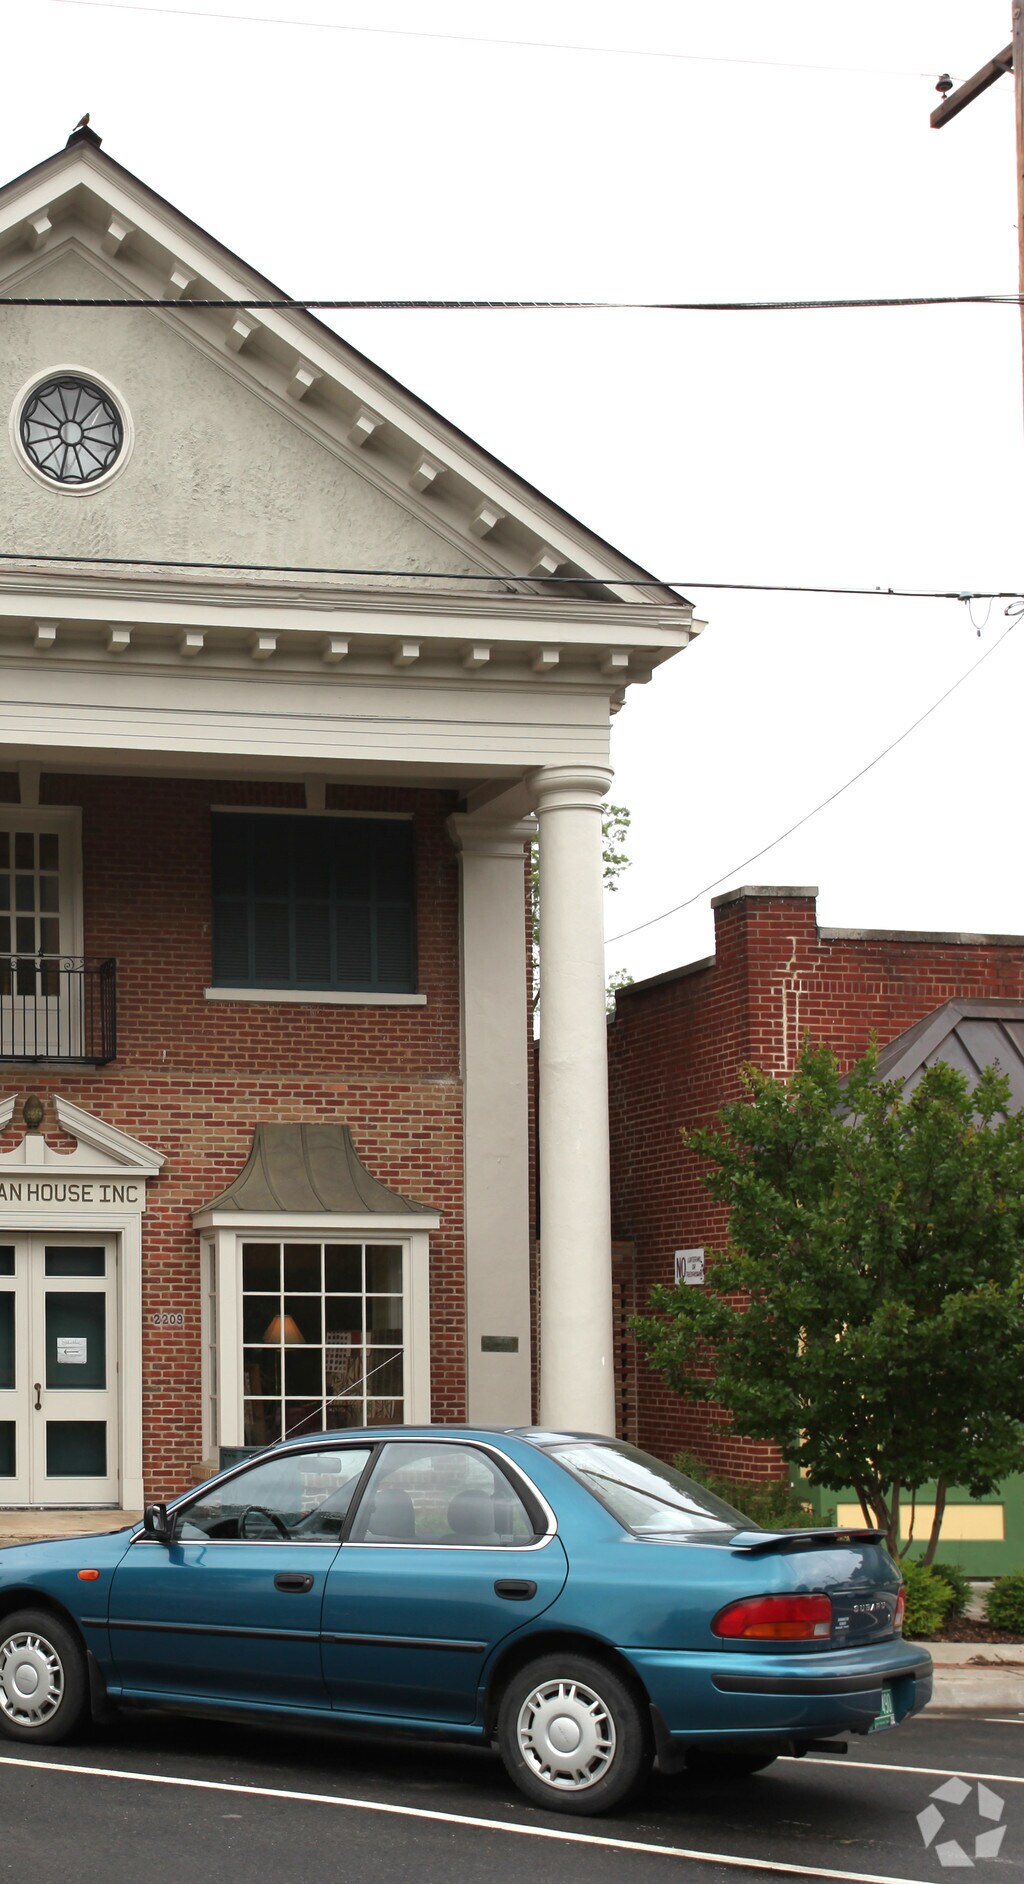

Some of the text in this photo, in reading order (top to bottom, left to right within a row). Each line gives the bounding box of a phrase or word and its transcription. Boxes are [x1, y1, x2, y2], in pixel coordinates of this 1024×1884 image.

[27, 1183, 94, 1203] HOUSE
[99, 1184, 138, 1204] INC
[676, 1256, 687, 1279] NO
[153, 1313, 183, 1325] 2209
[853, 1601, 886, 1613] SUBARU
